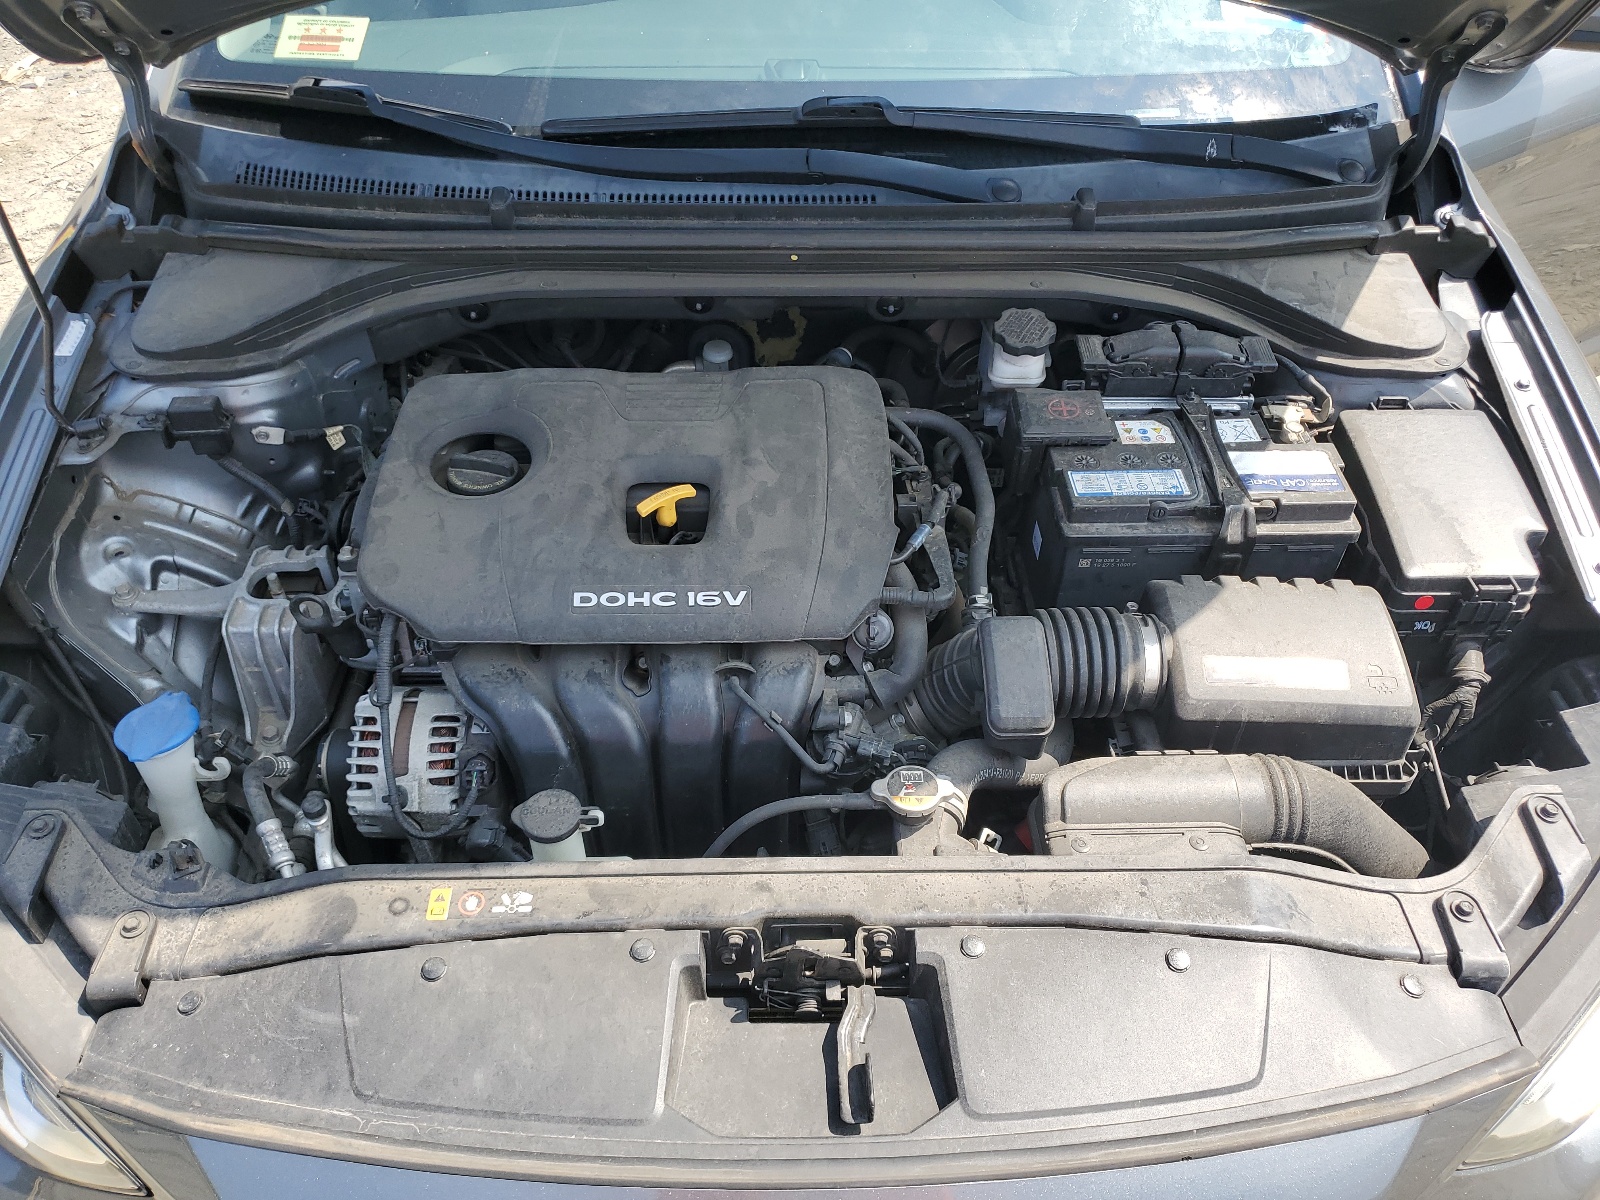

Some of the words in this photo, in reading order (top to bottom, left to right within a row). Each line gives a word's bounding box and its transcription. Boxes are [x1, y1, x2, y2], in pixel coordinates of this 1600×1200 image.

[1280, 478, 1306, 487] CAR
[573, 591, 677, 607] DOHC
[687, 590, 748, 606] 16V
